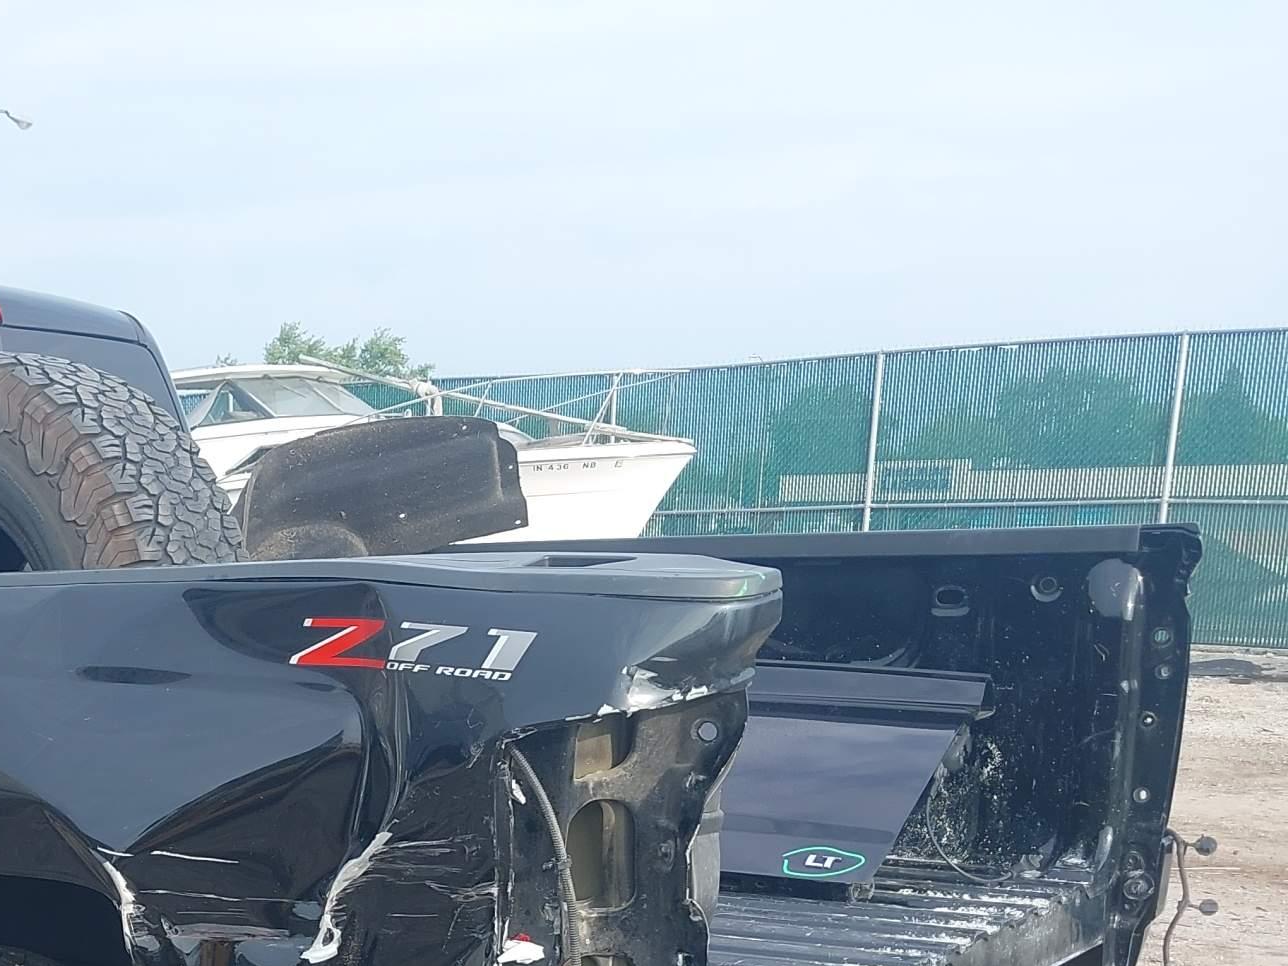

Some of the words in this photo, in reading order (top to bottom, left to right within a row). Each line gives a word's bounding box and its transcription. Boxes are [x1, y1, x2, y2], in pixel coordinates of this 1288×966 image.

[386, 660, 431, 673] OFF
[435, 665, 513, 681] ROAD
[804, 853, 843, 869] LT
